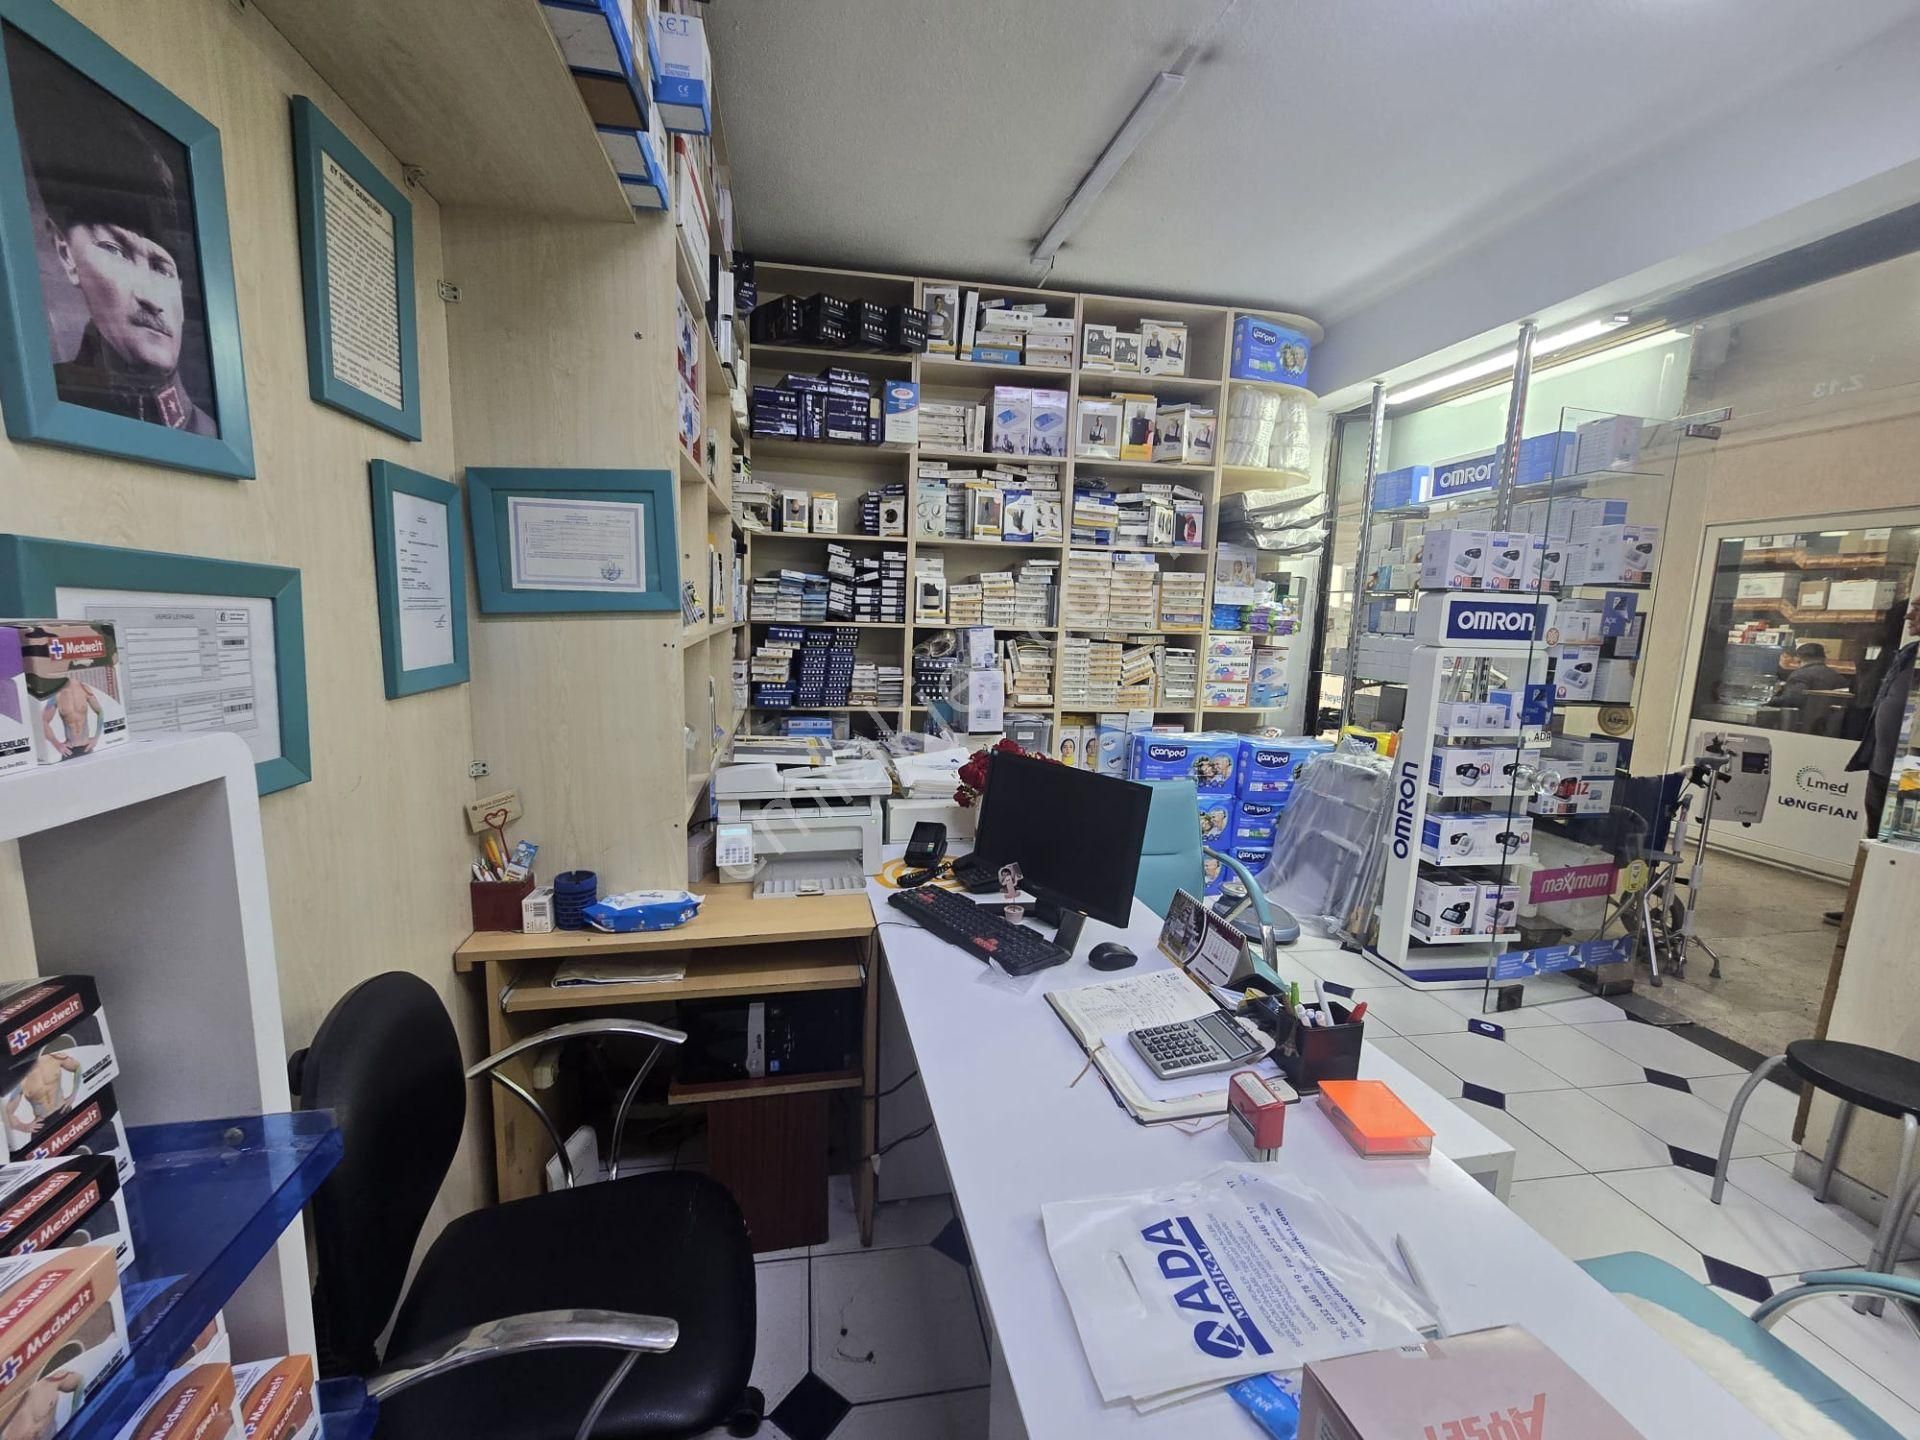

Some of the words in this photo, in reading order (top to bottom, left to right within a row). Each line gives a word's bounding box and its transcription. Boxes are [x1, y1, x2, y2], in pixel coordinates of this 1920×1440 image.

[1457, 610, 1536, 632] OMRON
[66, 641, 104, 654] Medwelt
[1807, 777, 1849, 795] Lmed
[1393, 761, 1419, 860] OMRON
[32, 1001, 80, 1036] Medwelt
[51, 1107, 98, 1151] Medwelt
[11, 1172, 69, 1220] Medwelt
[40, 1189, 97, 1244] Medwelt
[1140, 1217, 1224, 1315] ADA
[1293, 1273, 1303, 1281] 19
[27, 1289, 92, 1360] Medwelt
[254, 1375, 285, 1422] Medwelt
